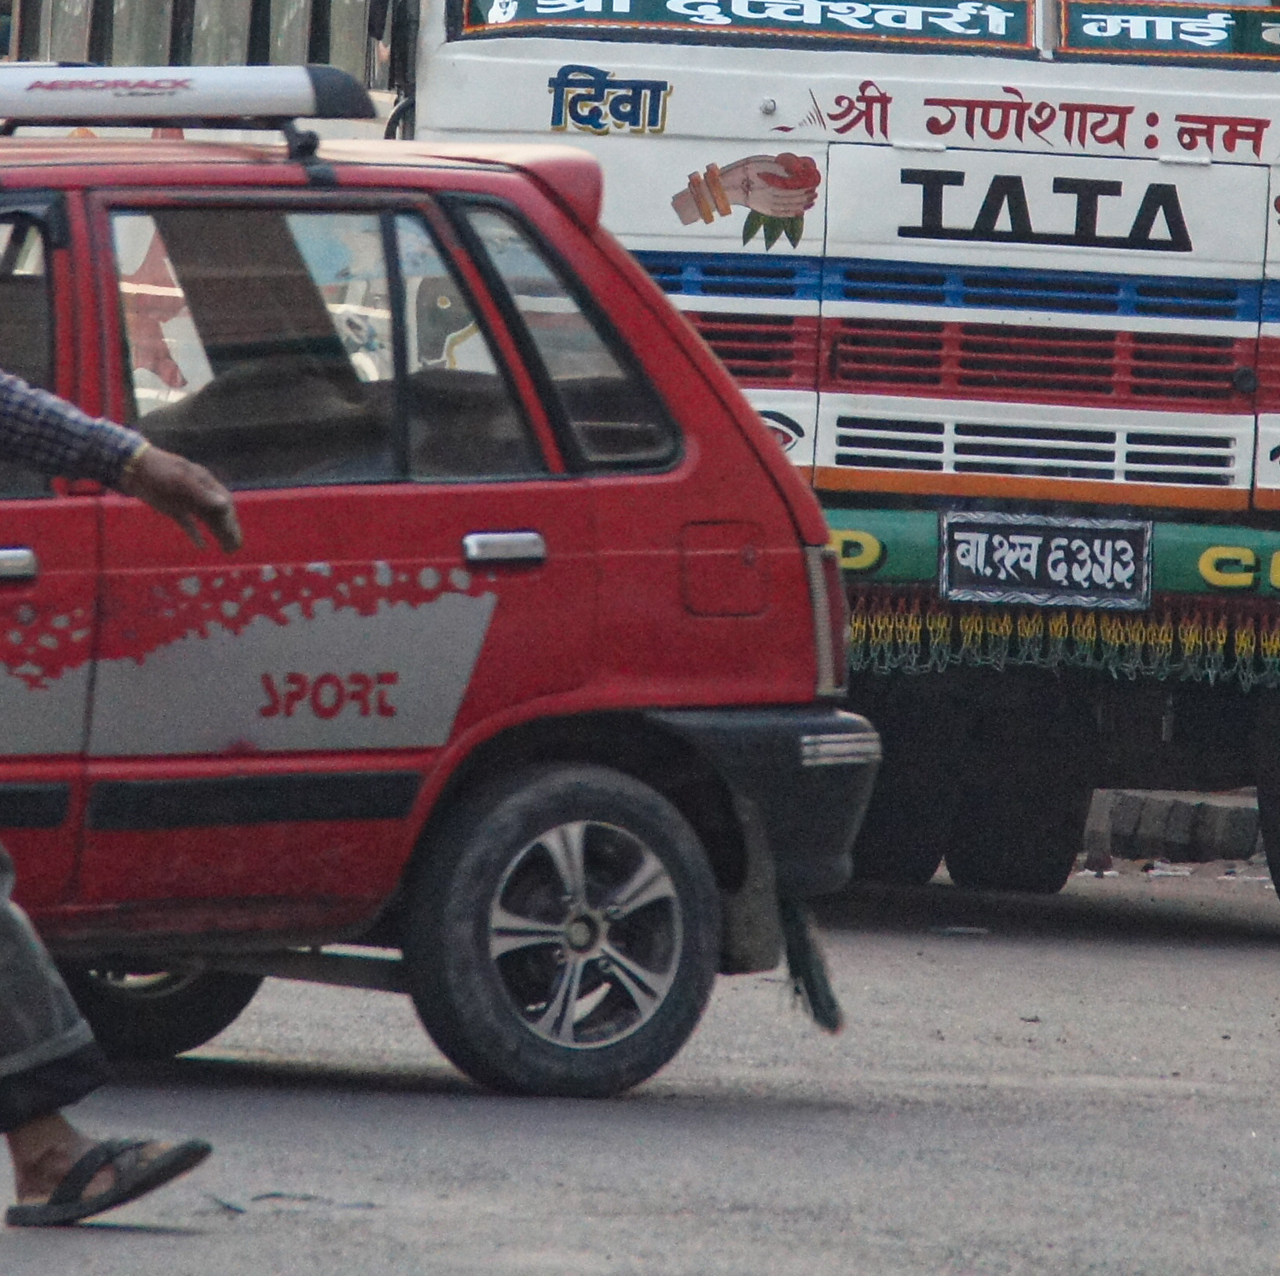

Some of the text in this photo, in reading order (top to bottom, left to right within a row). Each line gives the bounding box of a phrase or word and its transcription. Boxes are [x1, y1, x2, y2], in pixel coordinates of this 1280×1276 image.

[1081, 12, 1236, 46] माई
[826, 80, 893, 139] श्री
[896, 167, 1193, 253] TATA
[259, 671, 399, 719] SPORT
